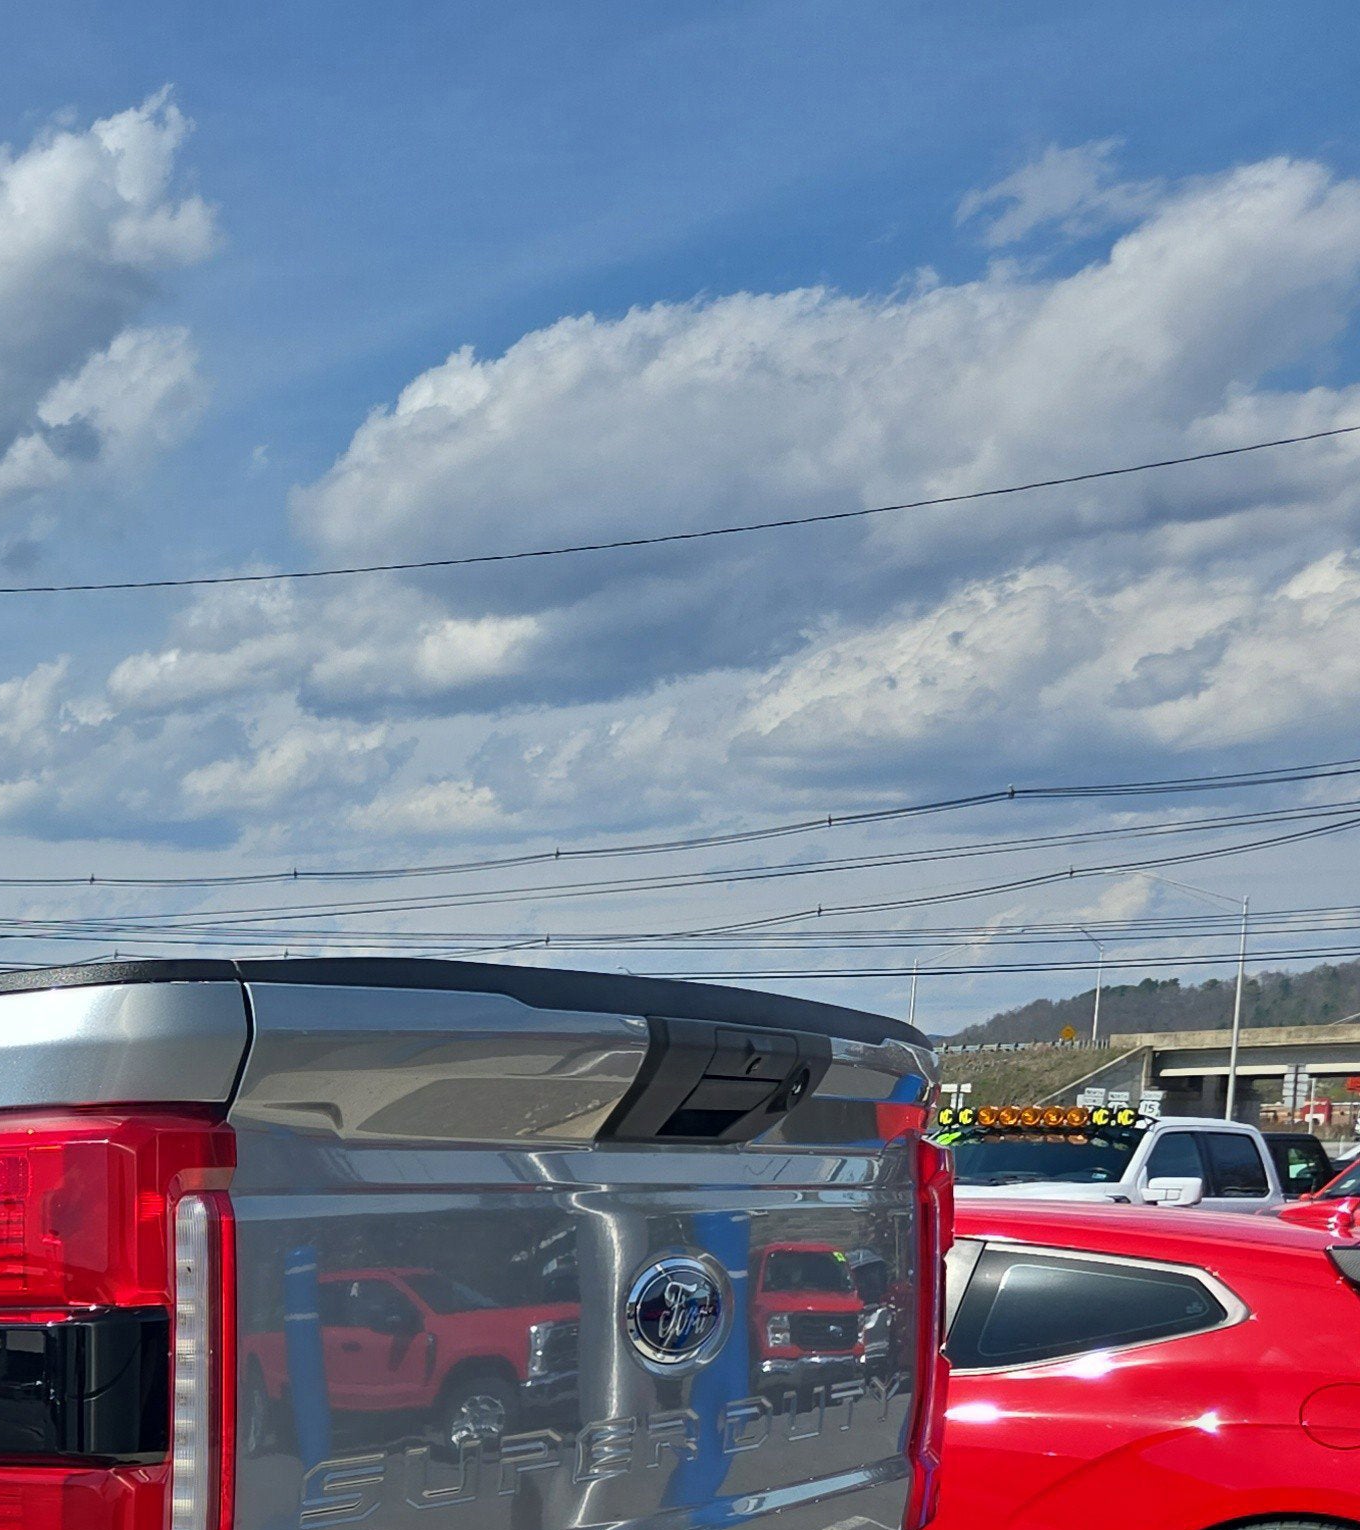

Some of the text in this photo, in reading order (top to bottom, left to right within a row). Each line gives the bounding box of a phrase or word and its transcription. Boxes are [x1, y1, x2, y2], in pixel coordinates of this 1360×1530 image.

[1143, 1103, 1155, 1114] 15
[657, 1280, 714, 1348] Ford
[298, 1376, 902, 1530] SUPER DUTY
